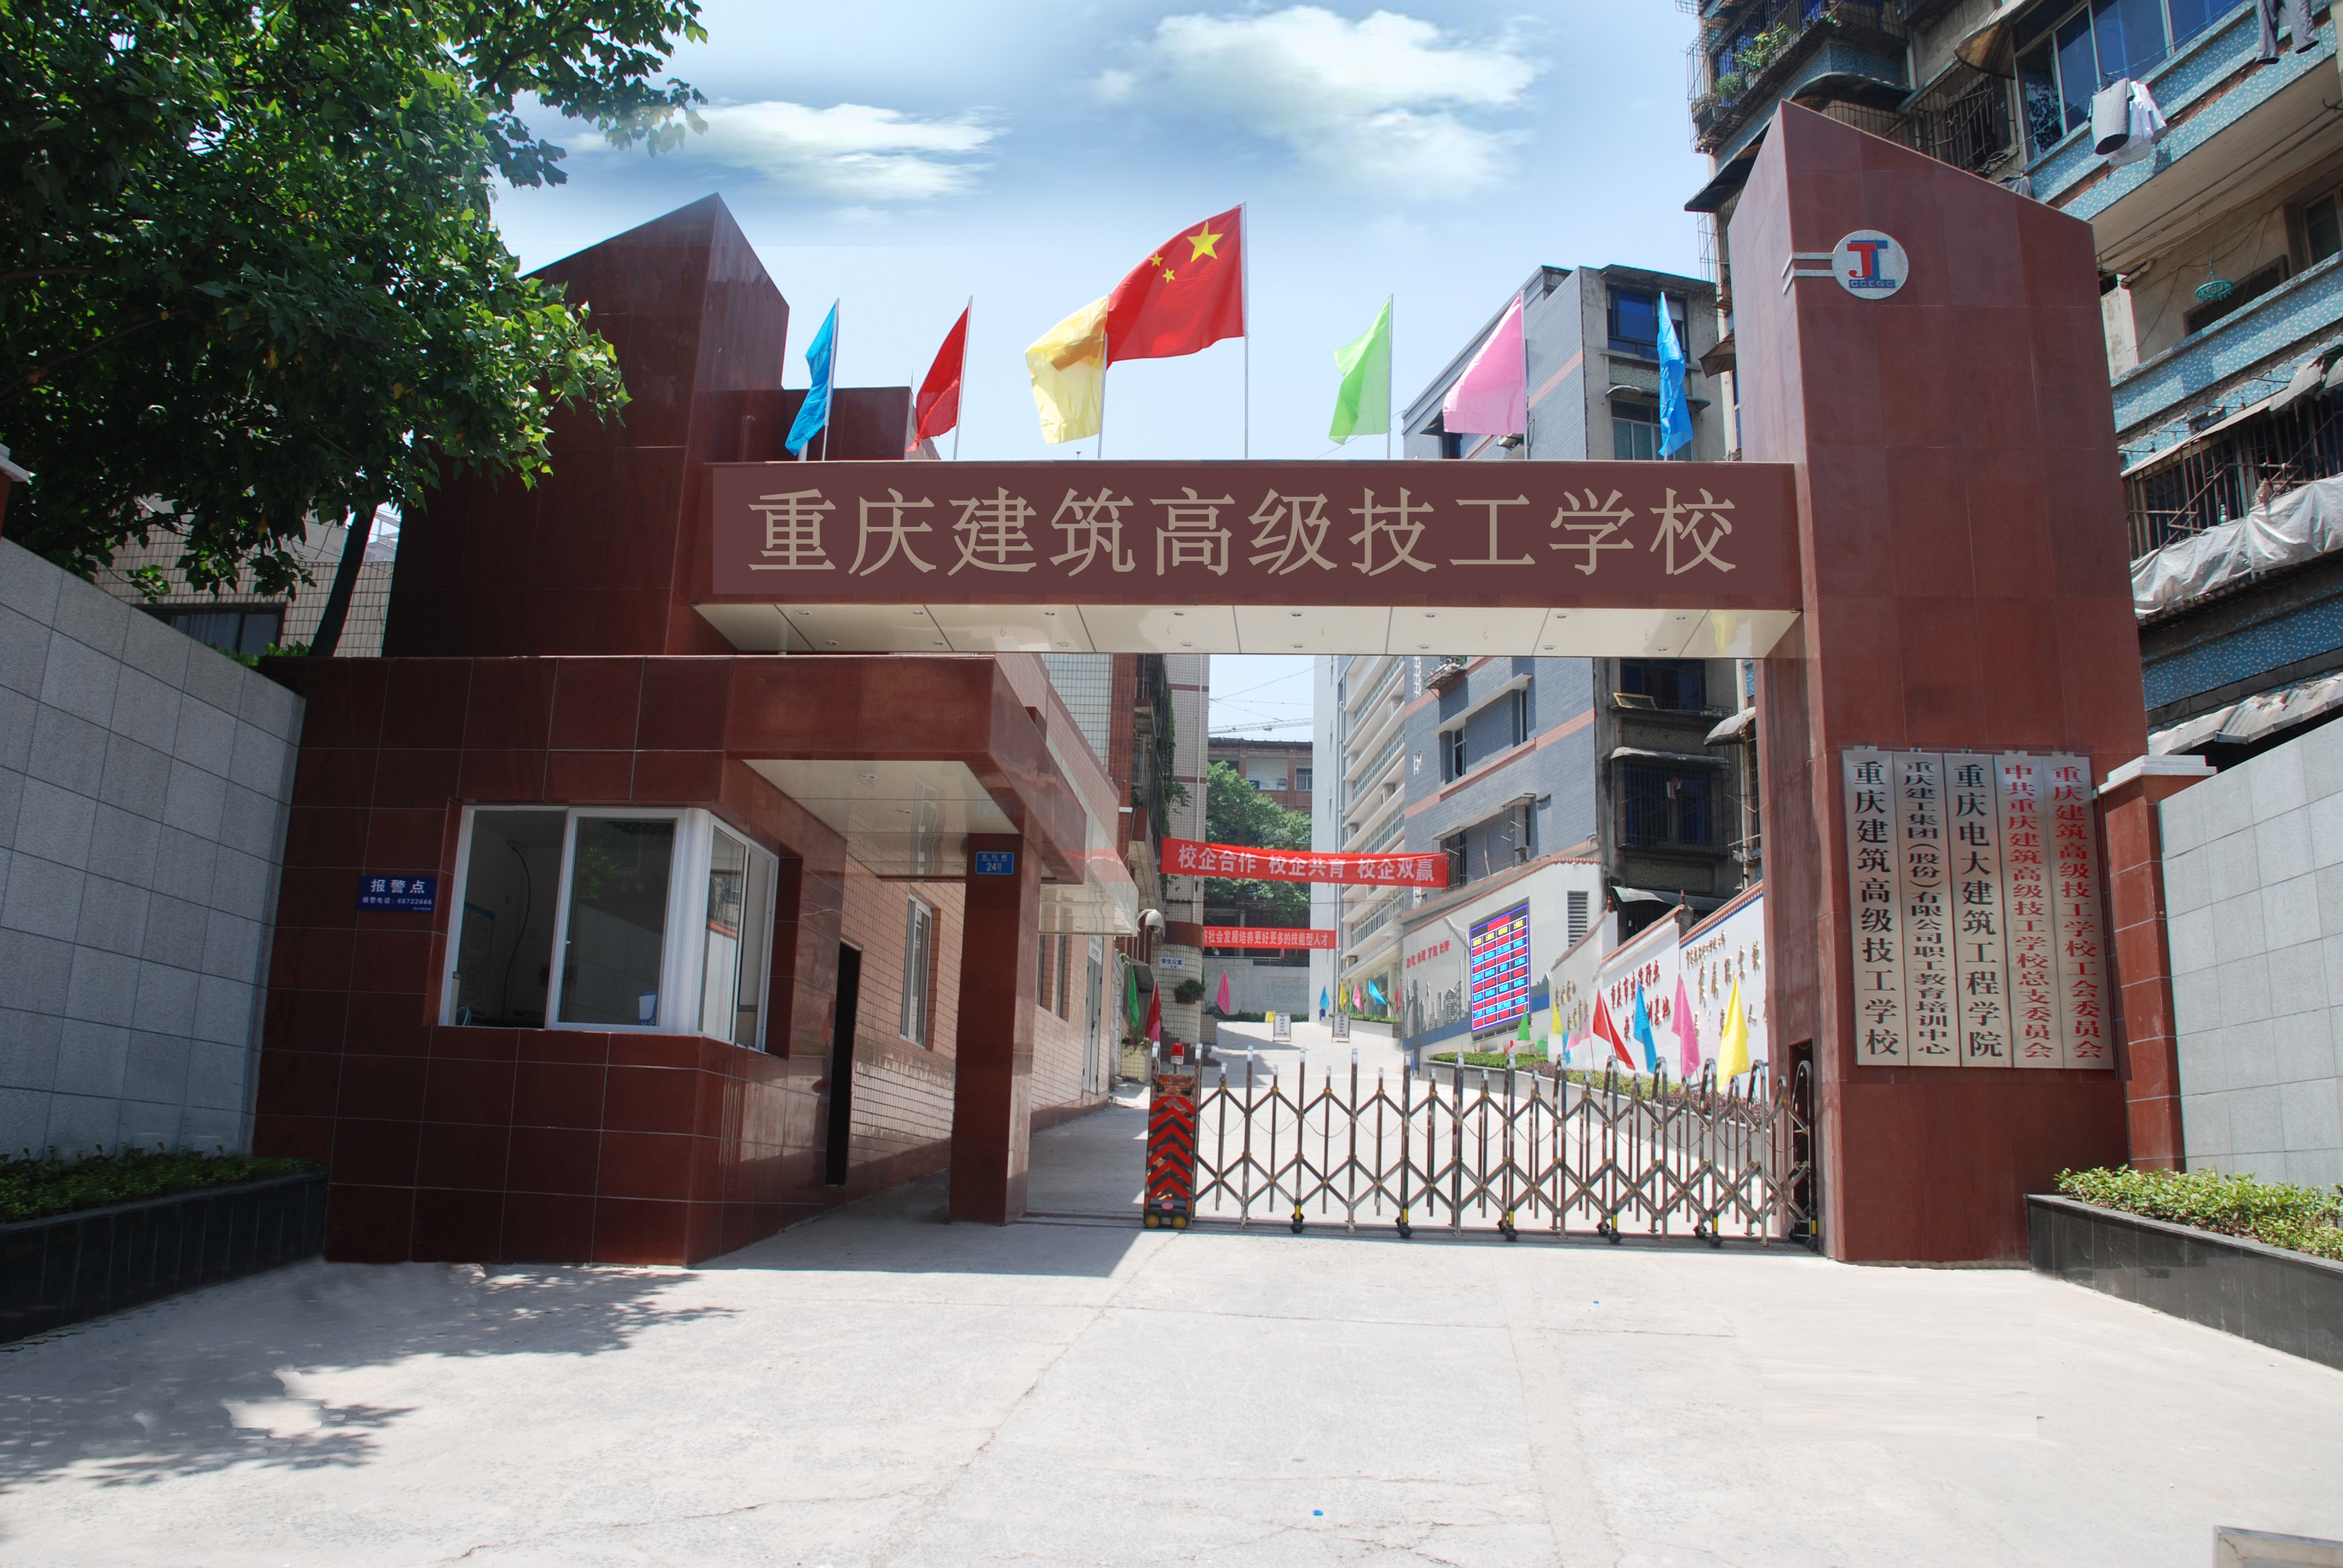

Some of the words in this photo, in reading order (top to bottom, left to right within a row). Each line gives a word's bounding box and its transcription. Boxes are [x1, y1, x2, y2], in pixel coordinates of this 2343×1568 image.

[747, 486, 1736, 577] 重庆建筑高级技工学校
[370, 879, 425, 893] 报警点
[1178, 843, 1257, 874] 校企合作
[1357, 857, 1434, 881] 校企双赢
[1853, 760, 1899, 1056] 重庆建筑高级技工学校
[1954, 763, 2004, 1057] 重庆电大建筑工程学院
[2004, 764, 2054, 1059] 中共重庆建筑高级技工学校总支委员会
[2052, 765, 2104, 1059] 重庆建筑高级技工学校工会委员会
